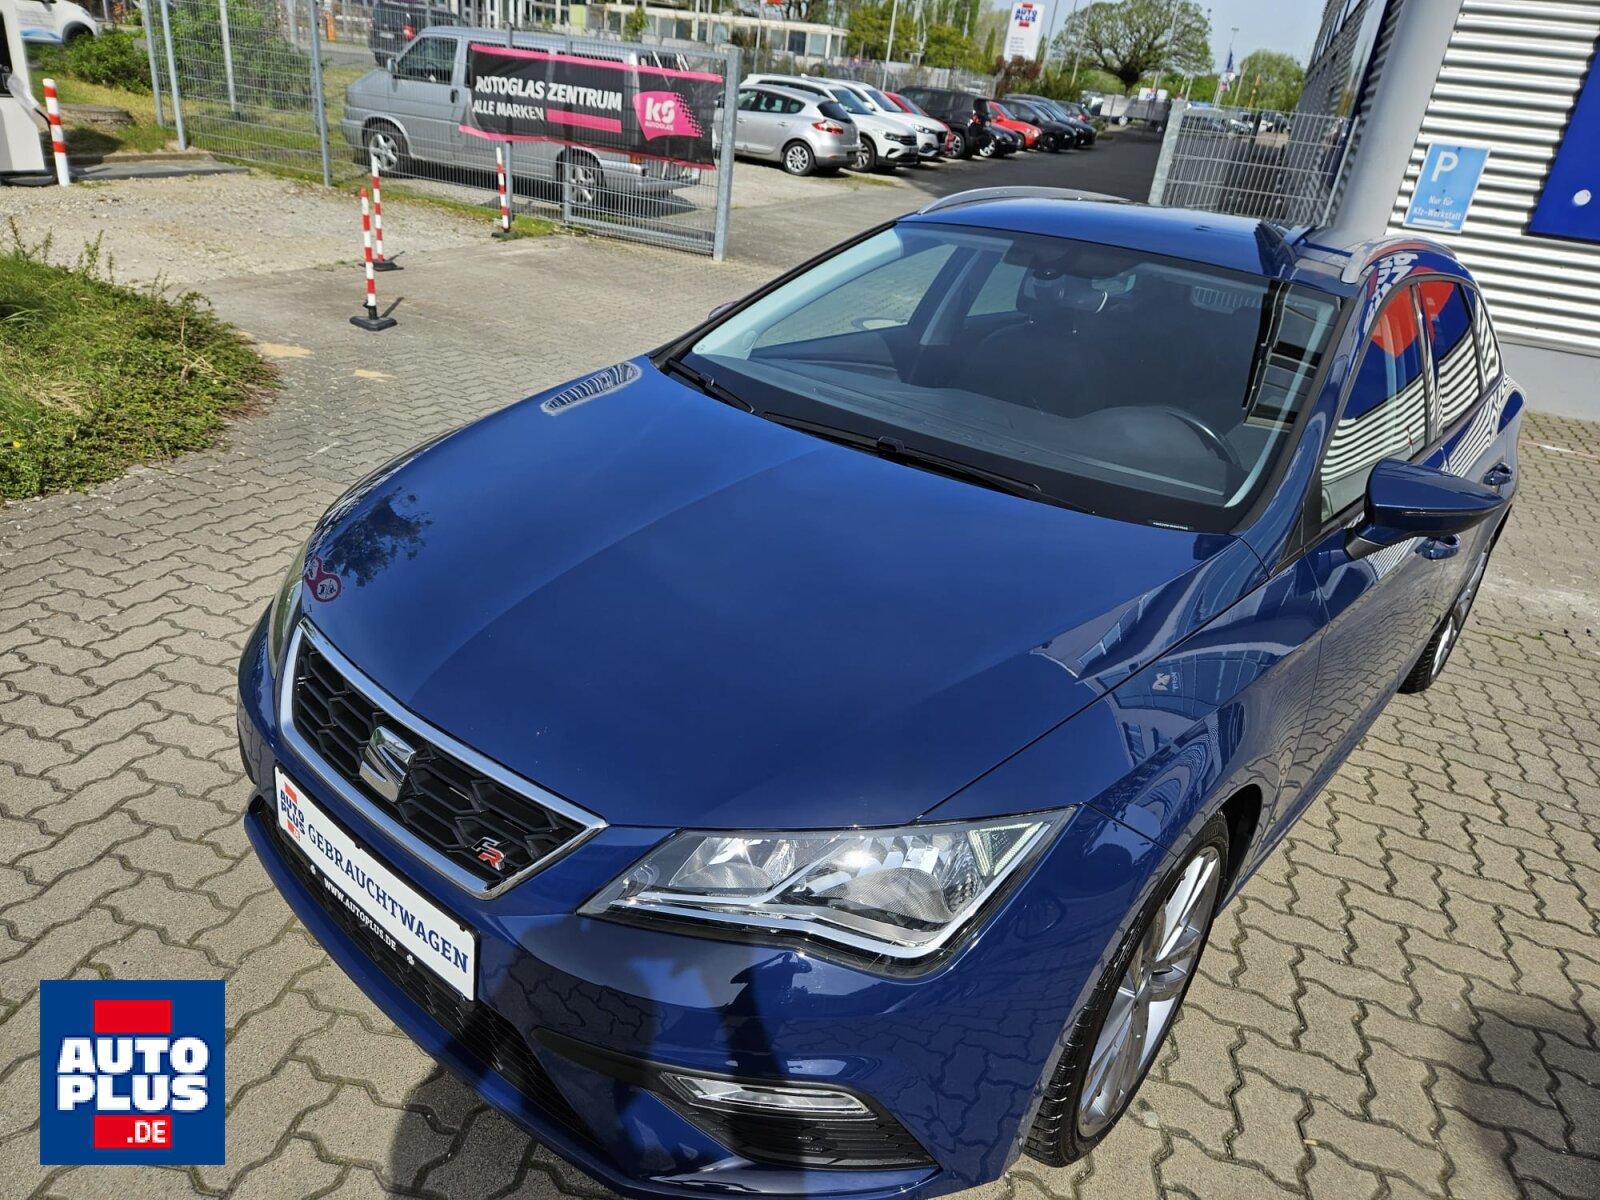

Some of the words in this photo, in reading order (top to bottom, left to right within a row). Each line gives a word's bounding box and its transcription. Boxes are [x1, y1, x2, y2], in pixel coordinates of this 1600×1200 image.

[1015, 8, 1037, 17] AUTO
[472, 99, 495, 115] ALLE
[496, 101, 545, 121] MARKEN
[475, 75, 545, 99] AUTOGLAS
[547, 82, 622, 111] ZENTRUM
[1431, 150, 1459, 182] P
[1429, 194, 1441, 205] Nur
[280, 789, 305, 823] AUTO
[280, 801, 306, 835] PLUS
[308, 823, 469, 974] GEBRAUCHTWAGEN
[323, 877, 397, 952] WWW.AUTOPLUS.DE
